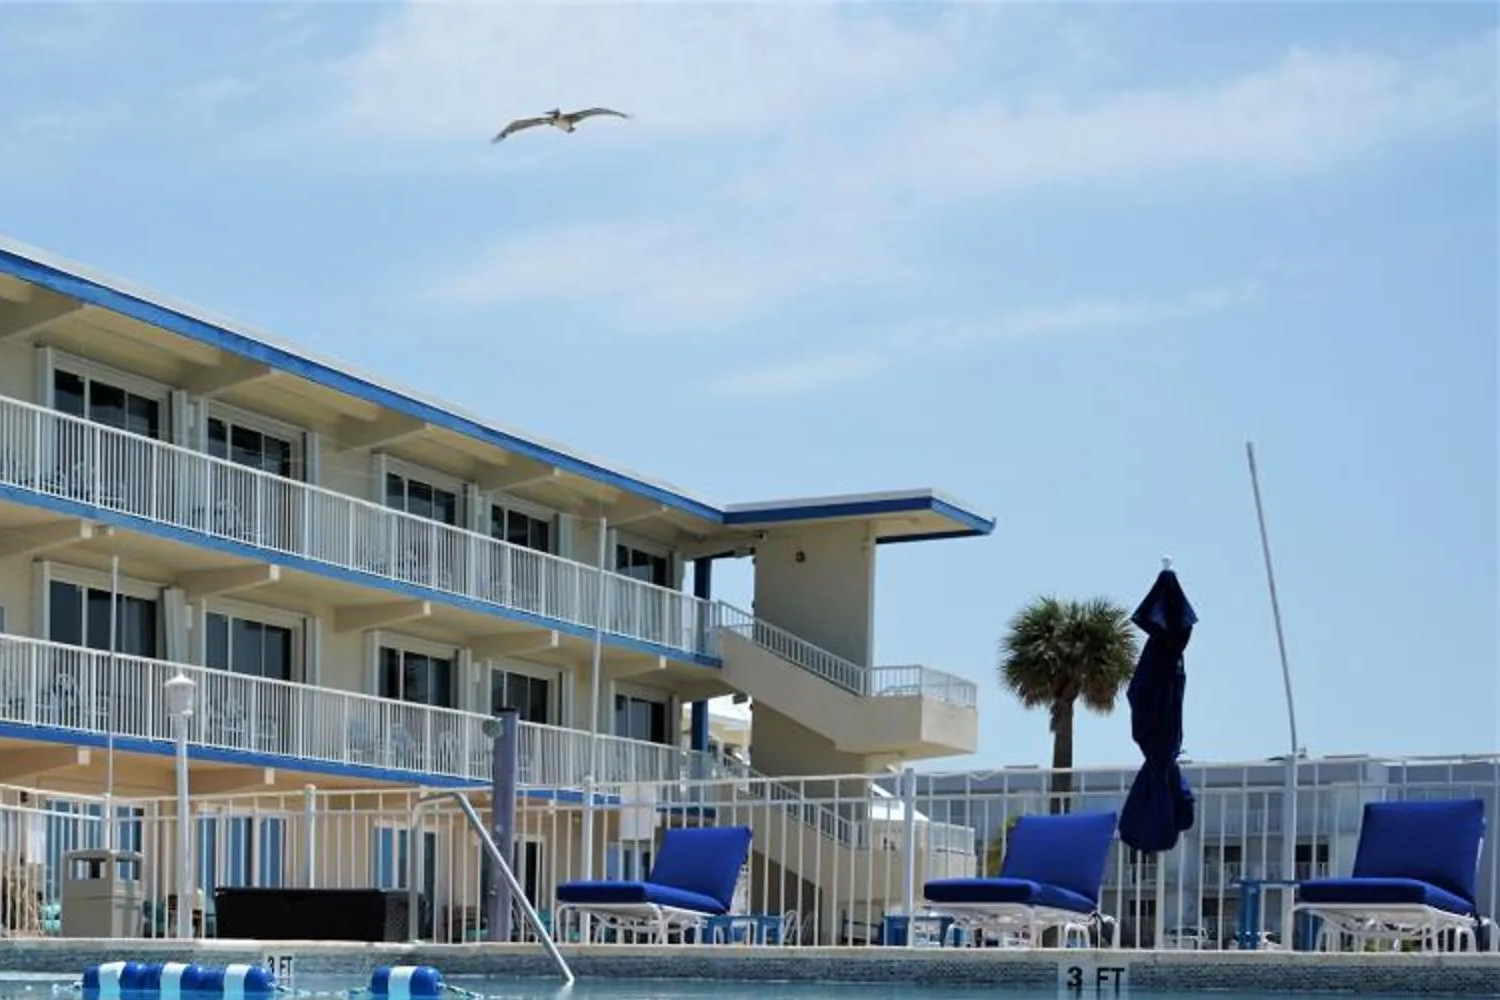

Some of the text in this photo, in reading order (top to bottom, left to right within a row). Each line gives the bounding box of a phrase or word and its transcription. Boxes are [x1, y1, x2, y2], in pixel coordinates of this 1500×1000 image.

[279, 955, 293, 977] FT
[1067, 966, 1125, 989] 3 FT
